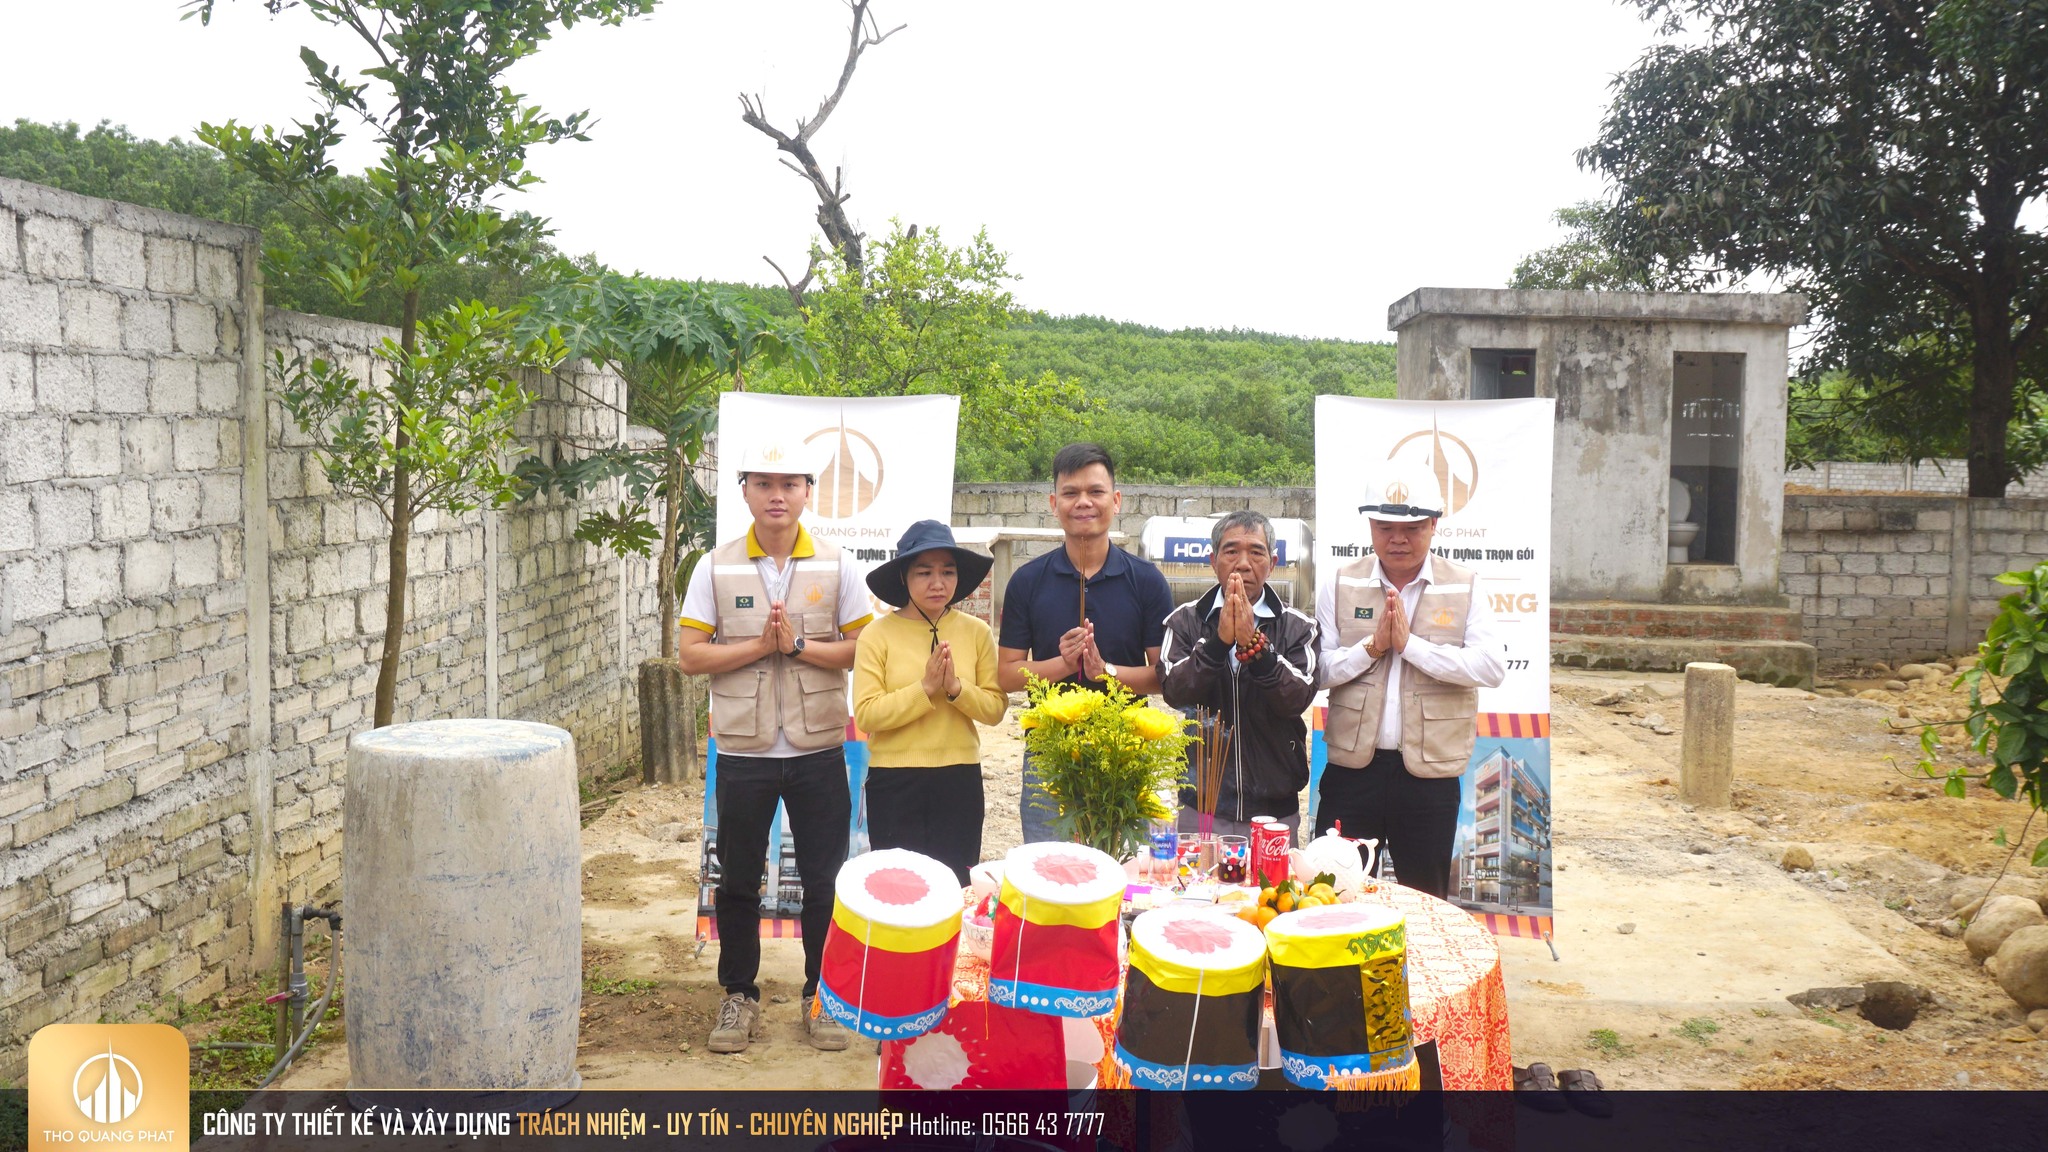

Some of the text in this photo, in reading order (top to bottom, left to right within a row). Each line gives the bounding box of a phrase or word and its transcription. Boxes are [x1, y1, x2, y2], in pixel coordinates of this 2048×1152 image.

[810, 526, 891, 538] QUANG PHAT
[1456, 528, 1487, 538] PHAT
[857, 548, 887, 563] DỰNG
[1331, 543, 1359, 557] THIẾT
[1453, 548, 1482, 562] DỰNG
[1485, 549, 1514, 563] TRỌN
[1517, 548, 1534, 560] GÓI
[1487, 593, 1538, 613] NG
